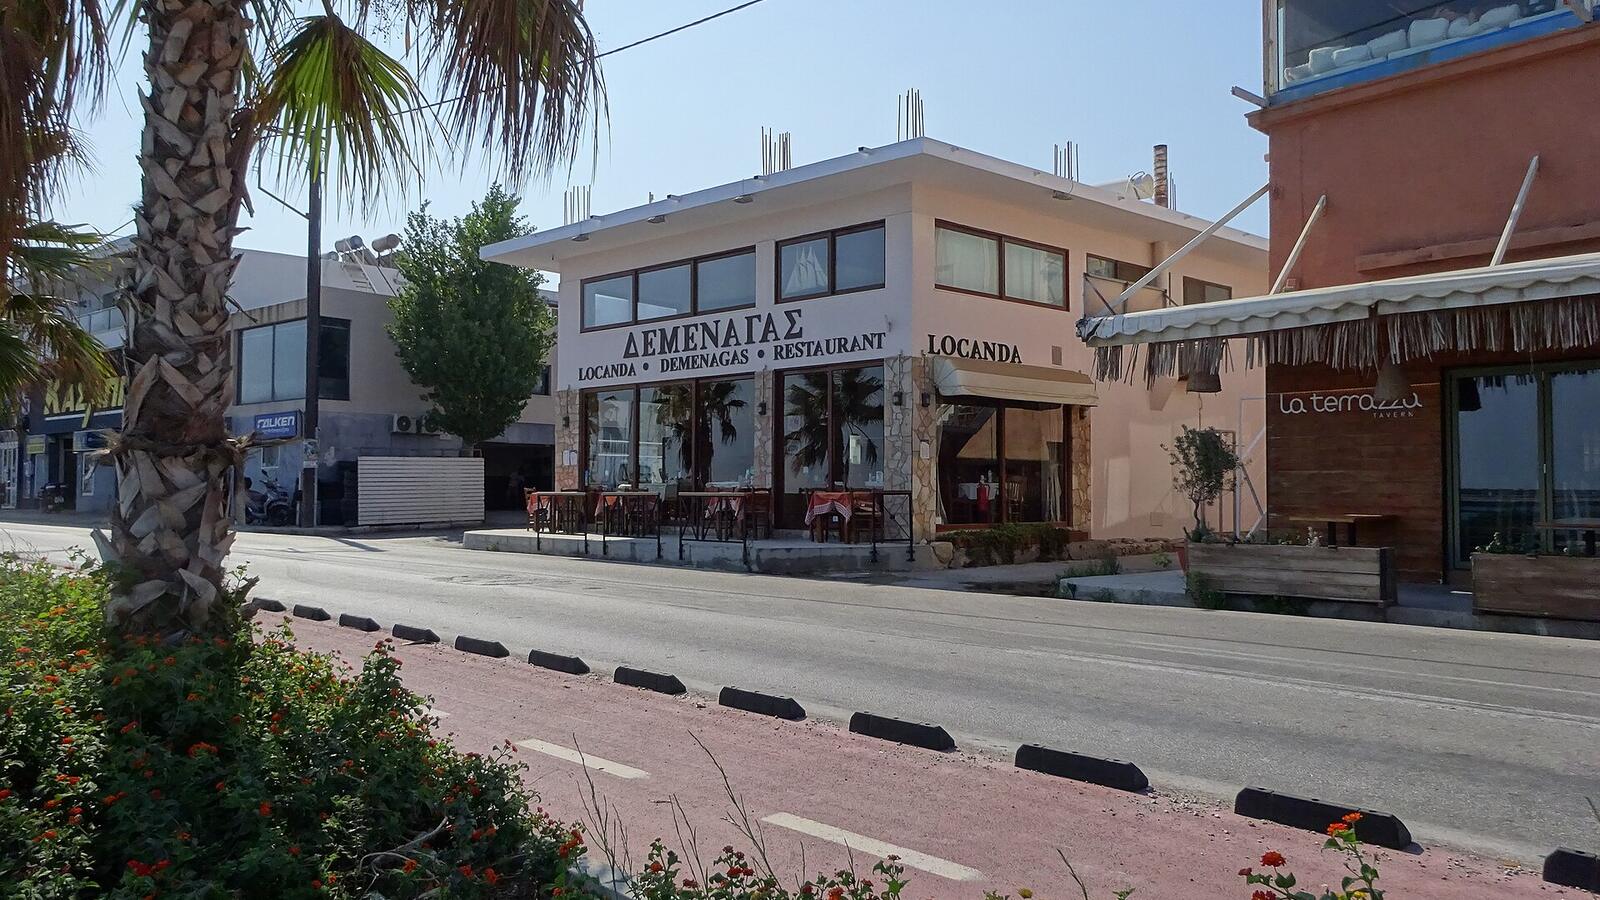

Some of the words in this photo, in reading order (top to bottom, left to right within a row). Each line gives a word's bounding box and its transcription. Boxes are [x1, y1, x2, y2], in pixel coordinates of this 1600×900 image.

[623, 309, 803, 359] ΔΕΜΕΝΑΓΑΣ
[927, 334, 1023, 364] LOCANDA
[578, 363, 637, 382] LOCANDA
[660, 349, 749, 373] DEMENAGAS
[773, 332, 886, 361] RESTAURANT
[256, 416, 296, 429] FALKEN
[1373, 411, 1415, 419] TAVERN
